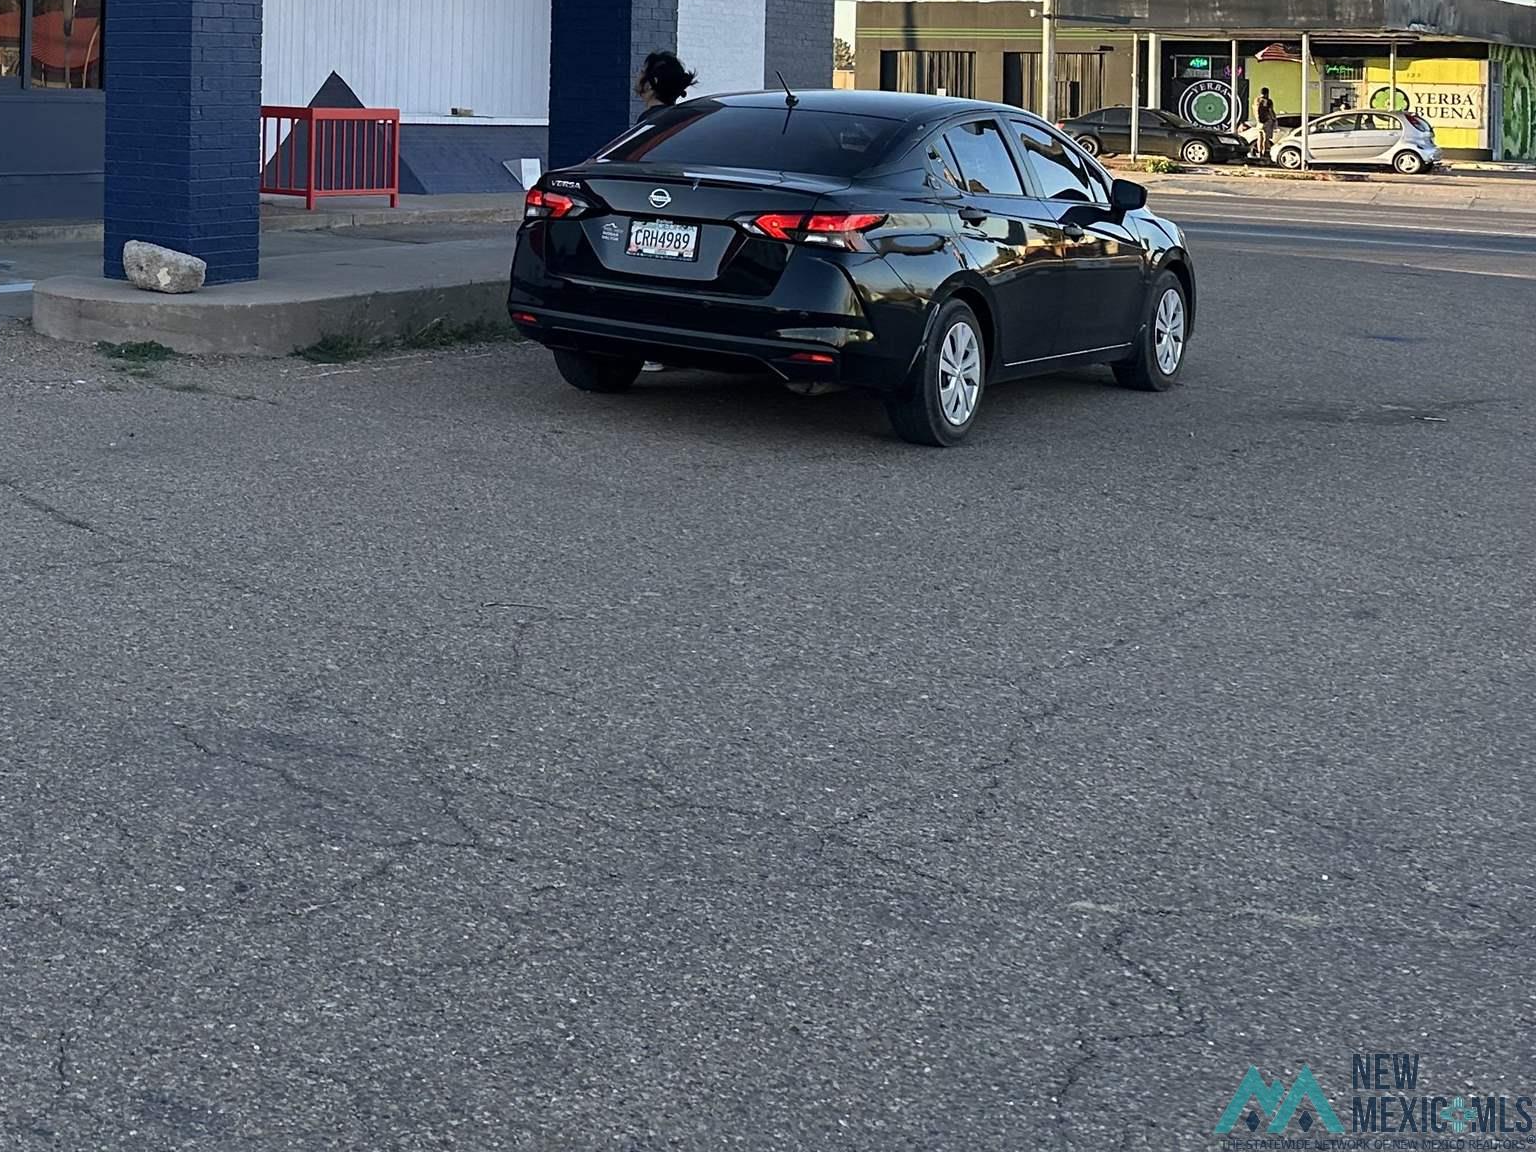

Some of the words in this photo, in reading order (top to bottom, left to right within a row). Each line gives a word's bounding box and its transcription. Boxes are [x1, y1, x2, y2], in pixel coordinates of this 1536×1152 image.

[1191, 82, 1229, 96] YERBA
[1414, 92, 1474, 105] YERBA
[1414, 106, 1476, 119] BUENA
[551, 179, 581, 189] VERSA
[634, 229, 691, 250] CRH4989
